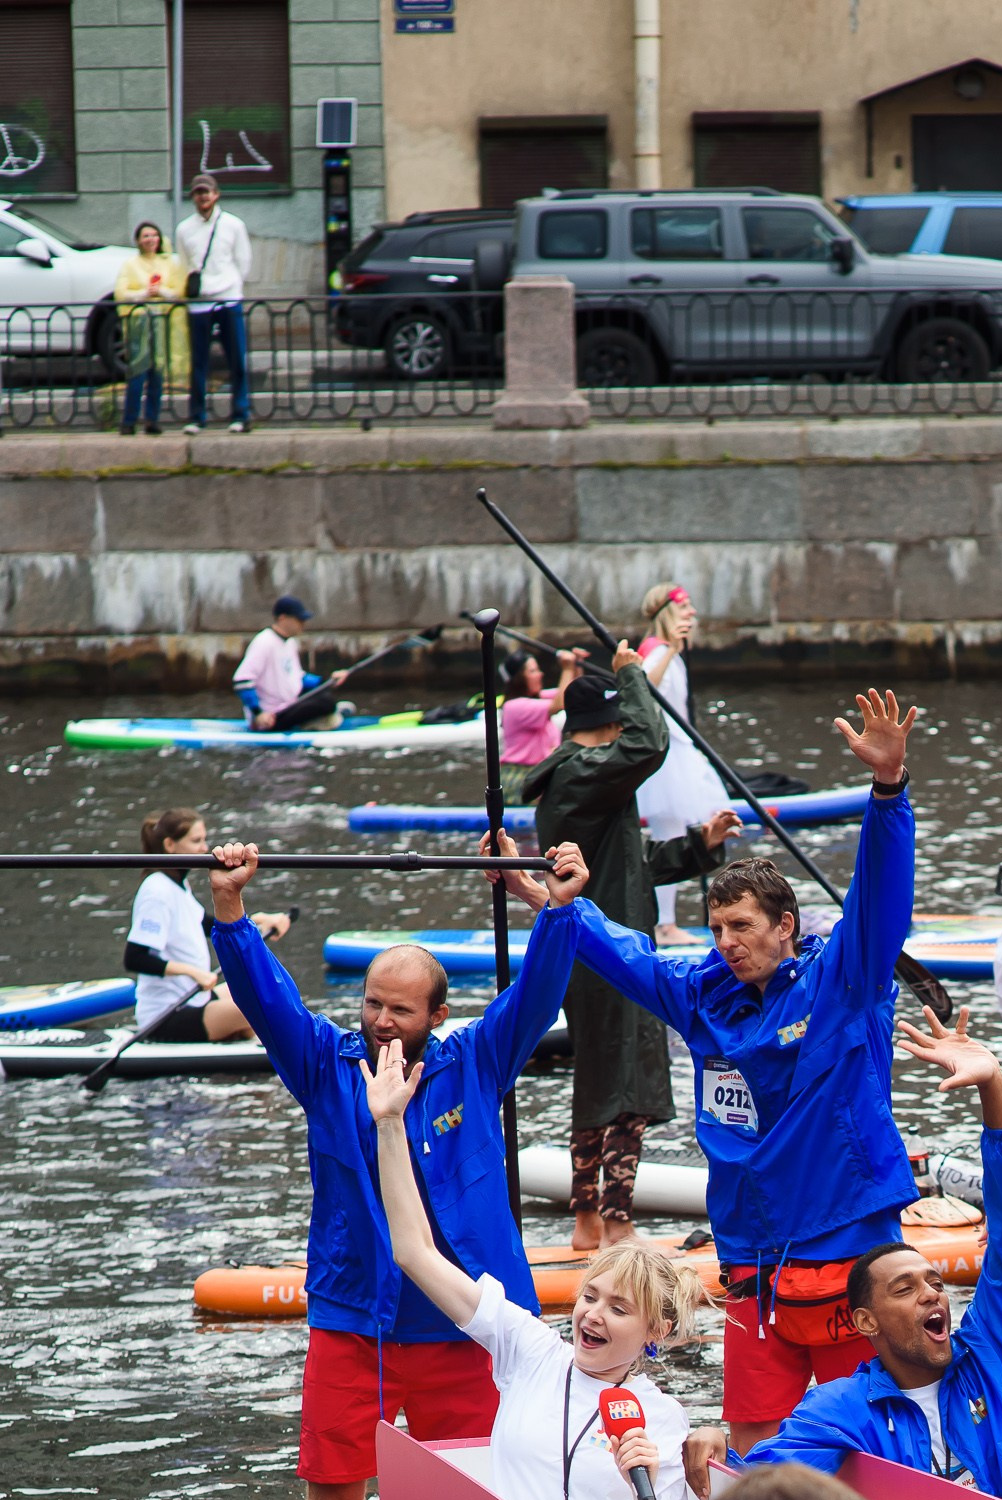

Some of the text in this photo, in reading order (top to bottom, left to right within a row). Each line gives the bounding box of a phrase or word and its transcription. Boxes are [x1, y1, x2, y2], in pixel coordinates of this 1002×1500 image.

[718, 1073, 743, 1081] ФОНТАН
[714, 1086, 752, 1109] 0212
[932, 1255, 984, 1273] MAR
[262, 1286, 308, 1304] FUS
